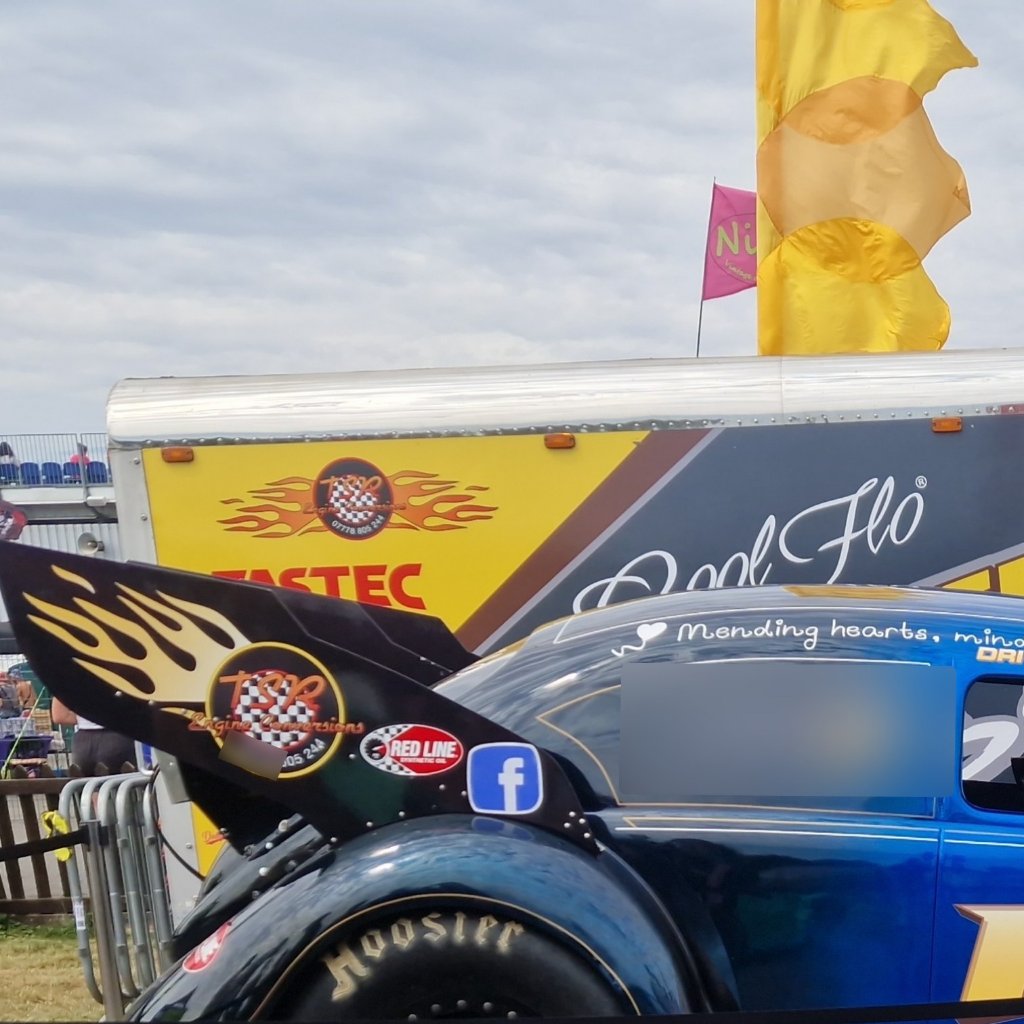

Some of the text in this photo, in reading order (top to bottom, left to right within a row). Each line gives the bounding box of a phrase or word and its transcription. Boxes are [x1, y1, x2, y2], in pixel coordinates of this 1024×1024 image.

[677, 618, 819, 650] Mending
[831, 619, 940, 643] hearts,
[219, 670, 327, 711] TSR
[189, 712, 253, 737] Engine
[303, 738, 326, 761] 244
[391, 740, 458, 758] RED LINE
[322, 911, 526, 1001] Hoosier
